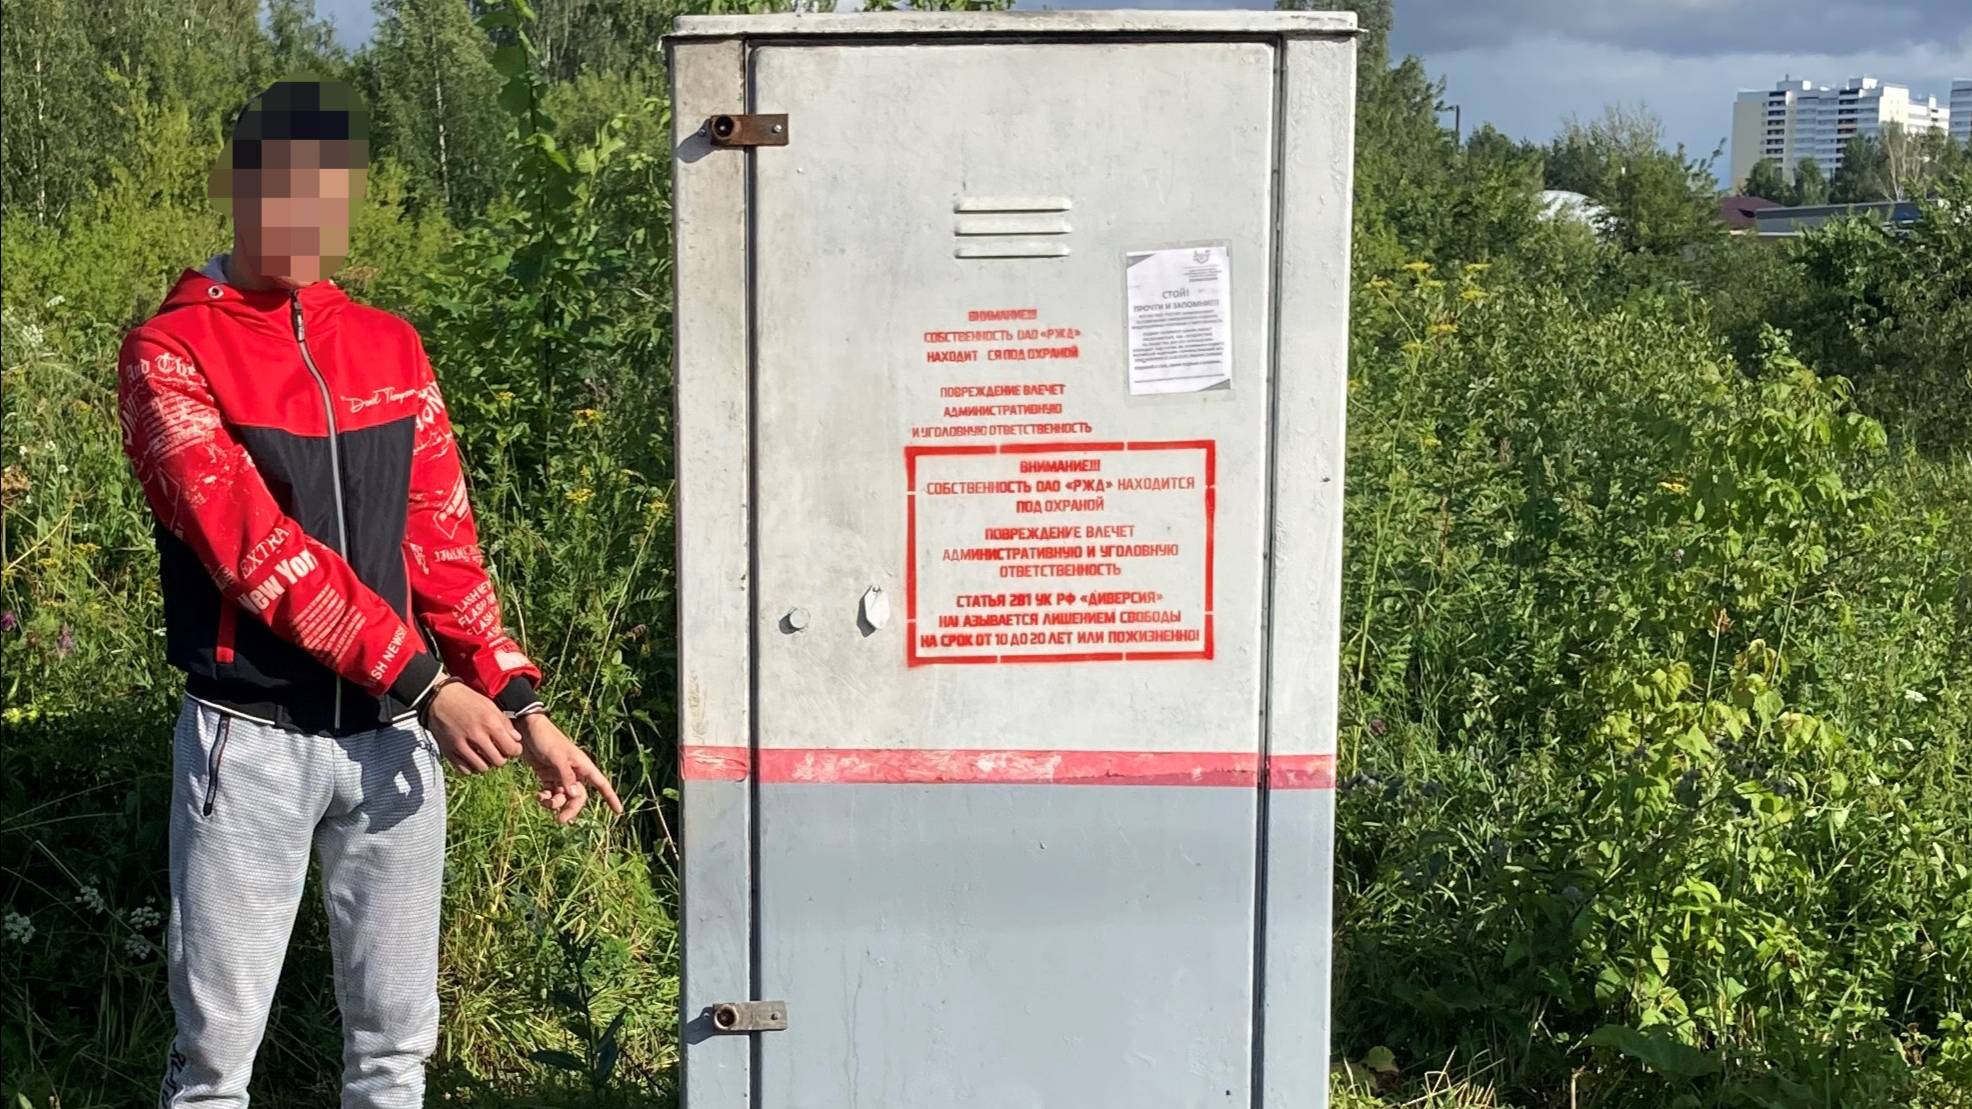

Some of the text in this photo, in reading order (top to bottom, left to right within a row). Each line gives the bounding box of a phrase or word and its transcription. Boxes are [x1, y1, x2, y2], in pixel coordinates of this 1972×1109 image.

[1162, 288, 1190, 299] СТОЙ!
[1133, 303, 1164, 313] ПРОЧТИ
[923, 327, 1081, 343] СОБСТВЕННОСТЬ ОАО «РЖД»
[1003, 348, 1025, 361] ПОД
[1027, 344, 1079, 359] ОХРАНОЙ
[940, 383, 1066, 398] ПОВРЕЖДЕНИЕ ВЛЕЧЕТ
[943, 403, 1062, 417] АДМИНИСТРАТИВНУЮ
[911, 422, 1092, 438] И УГОЛОВНУЮ ОТВЕТСТВЕННОСТЬ
[1020, 459, 1101, 473] ВНИМАНИЕ!!!
[926, 477, 1195, 495] СОБСТВЕННОСТЬ ОАО «РЖД» НАХОДИТСЯ
[1016, 496, 1105, 513] ПОД ОХРАНОЙ
[985, 525, 1135, 541] ПОВРЕЖДЕНИЕ ВЛЕЧЕТ
[239, 527, 291, 580] EXTRA
[942, 544, 1179, 562] АДМИНИСТРАТИВНУЮ И УГОЛОВНУЮ
[1000, 564, 1121, 578] ОТВЕТСТВЕННОСТЬ
[956, 591, 1164, 608] СТАТЬЯ 281 УК РФ «ДИВЕРСИЯ»
[1043, 611, 1116, 626] ЛИШЕНИЕМ
[1120, 610, 1182, 623] СВОБОДЫ
[920, 629, 1200, 648] НА СРОК ОТ 10 ДО 20 ЛЕТ ИЛИ ПОЖИЗНЕННО!
